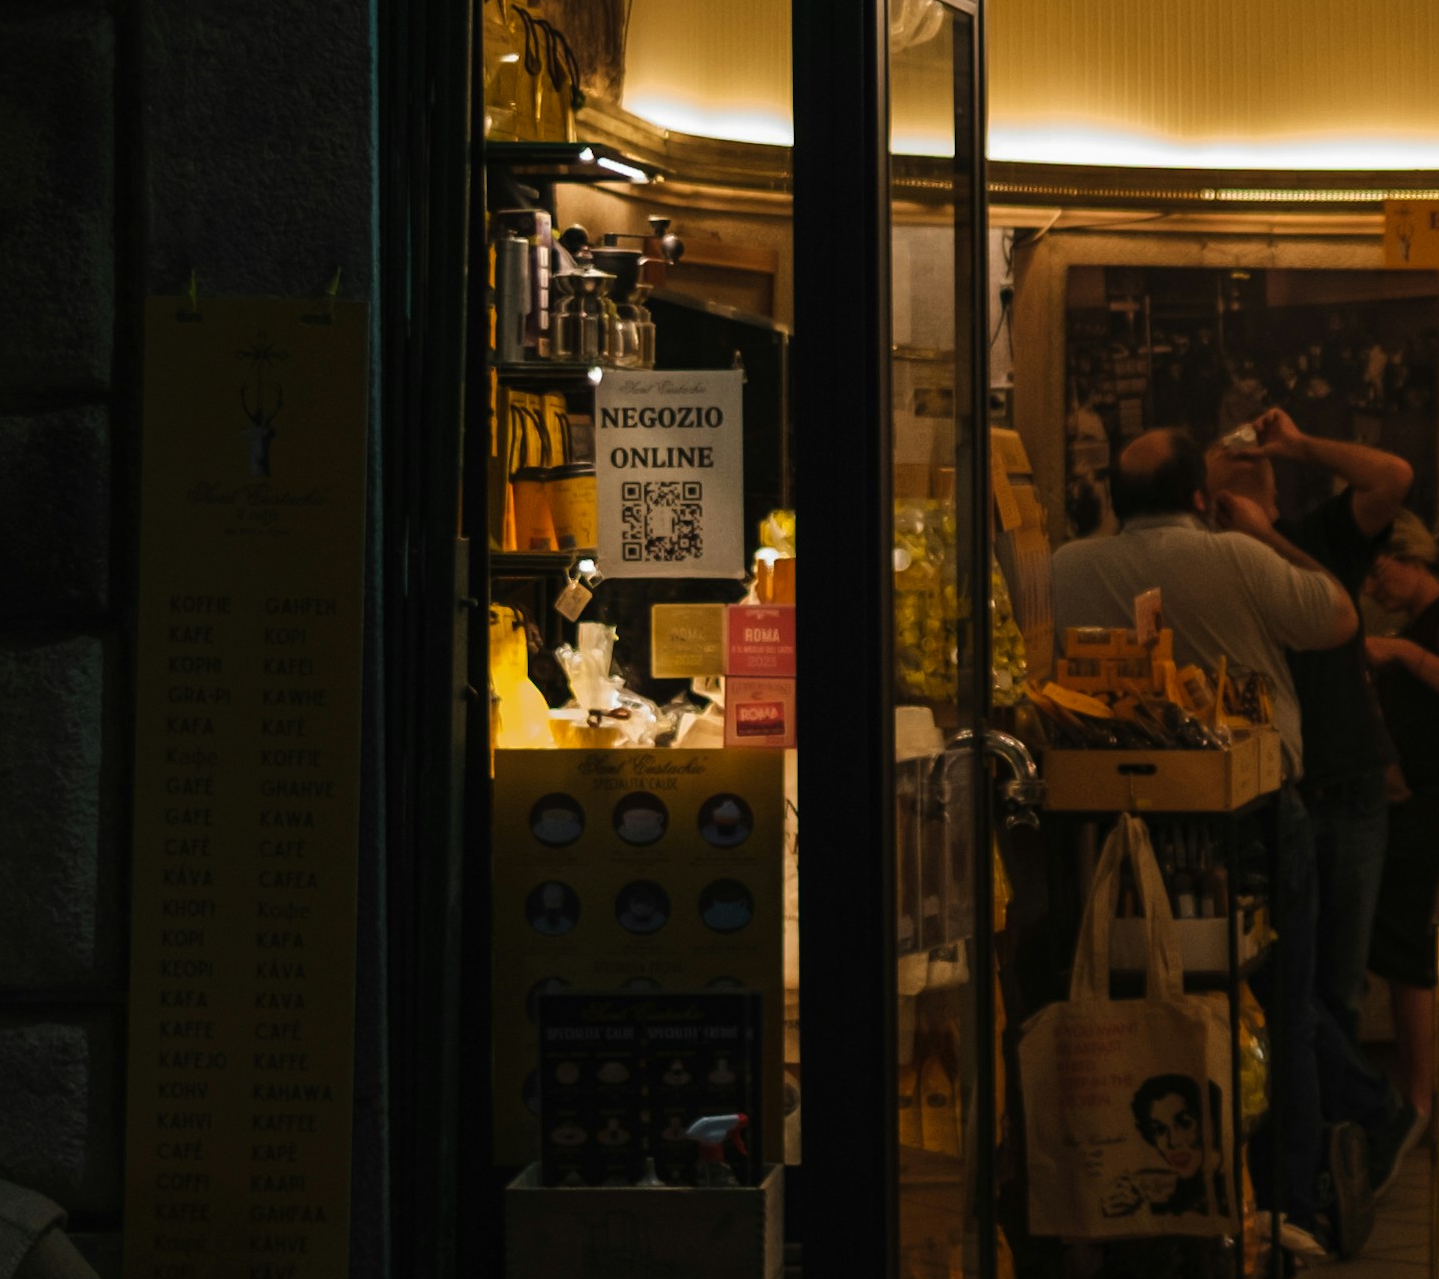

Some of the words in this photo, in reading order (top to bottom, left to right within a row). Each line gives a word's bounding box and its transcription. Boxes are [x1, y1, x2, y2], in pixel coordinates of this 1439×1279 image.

[600, 406, 724, 429] NEGOZIO
[611, 445, 715, 469] ONLINE
[169, 594, 232, 614] KOFFIE
[264, 597, 338, 616] GAHFEH
[262, 627, 308, 646] KOPI
[744, 627, 781, 643] ROMA
[168, 656, 223, 674] KOPHI
[167, 686, 232, 706] GRA-PI
[262, 689, 328, 708] KAWHE
[740, 706, 779, 722] ROMA
[166, 718, 216, 736] KAFA
[259, 749, 324, 768] KOFFIE
[260, 779, 336, 800] GHAHVE
[259, 811, 316, 830] KAWA
[163, 835, 212, 858] CAFÉ
[257, 870, 319, 890] CAFEA
[162, 900, 216, 918] KHOFI
[161, 930, 206, 948] KOPI
[255, 932, 306, 950] KAFA
[160, 960, 214, 979] KEOPI
[160, 991, 209, 1009] KAFA
[254, 992, 307, 1011] KAVA
[159, 1021, 216, 1041] KAFFE
[158, 1051, 229, 1071] KAFEJO
[252, 1052, 311, 1072] KAFFE
[157, 1082, 210, 1101] KOHV
[251, 1083, 335, 1104] KAHAWA
[156, 1113, 213, 1132] KAHVI
[251, 1113, 319, 1135] KAFFEE
[155, 1137, 205, 1162] CAFÉ
[249, 1174, 307, 1194] KAAPI
[248, 1204, 328, 1225] GAHFAA
[248, 1235, 310, 1256] KAHVE
